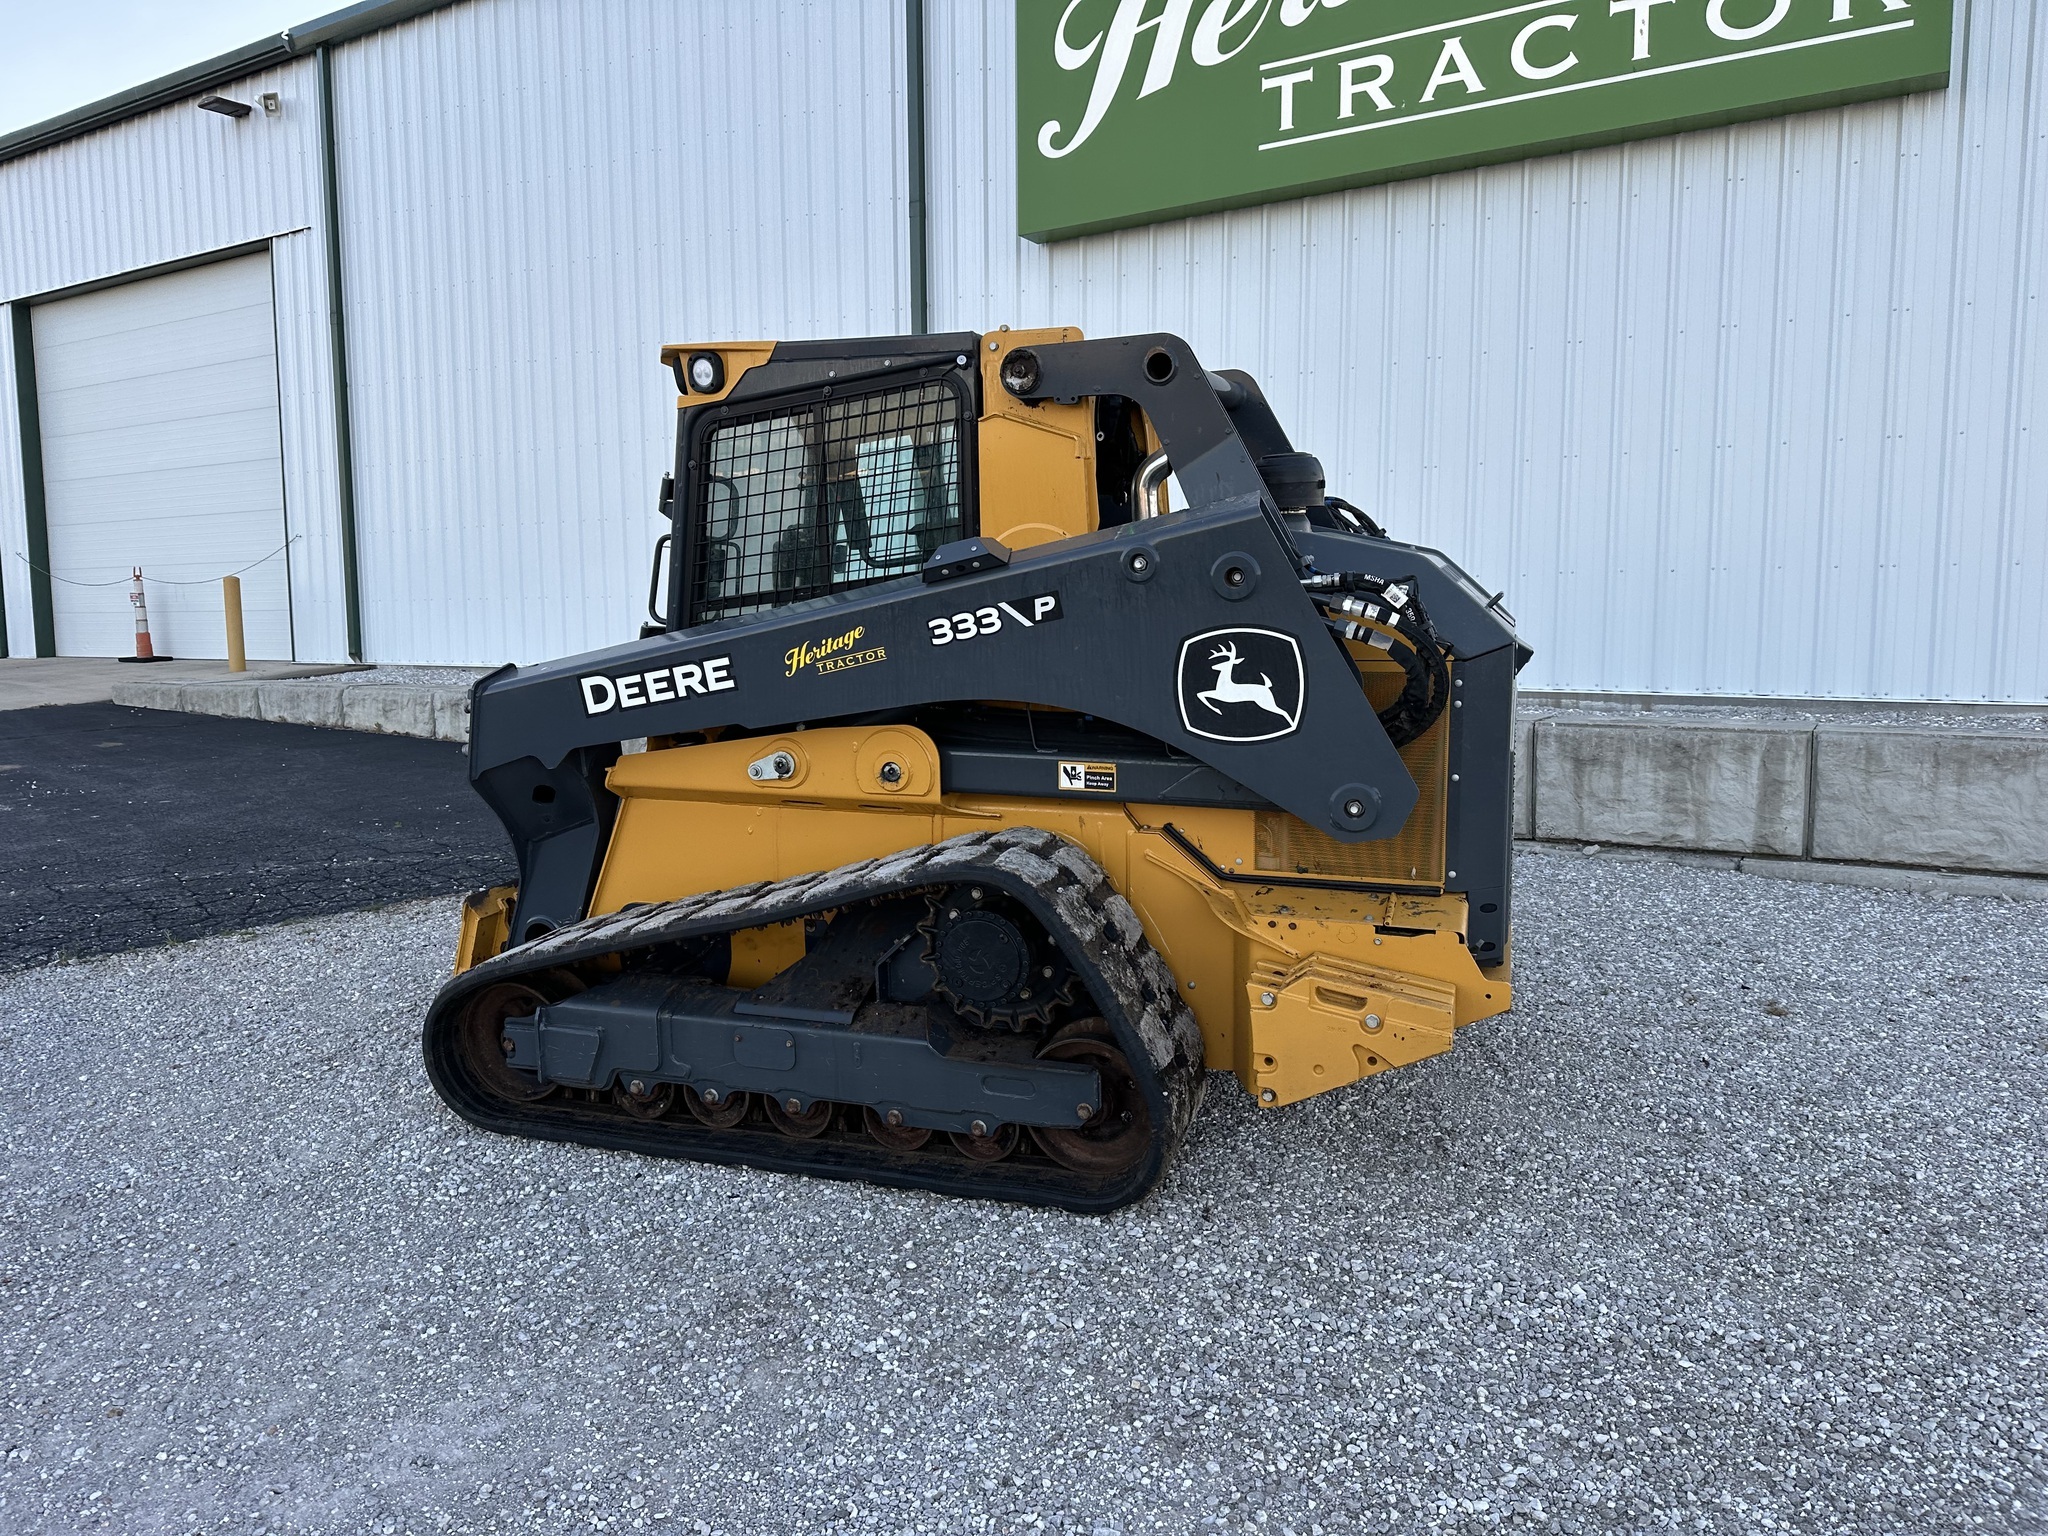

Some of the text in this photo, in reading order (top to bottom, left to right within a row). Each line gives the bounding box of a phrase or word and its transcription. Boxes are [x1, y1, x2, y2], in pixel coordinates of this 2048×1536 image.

[1364, 574, 1385, 585] MSHA
[784, 625, 865, 677] Heritage
[816, 649, 886, 672] TRACTOR
[580, 656, 735, 714] DEERE
